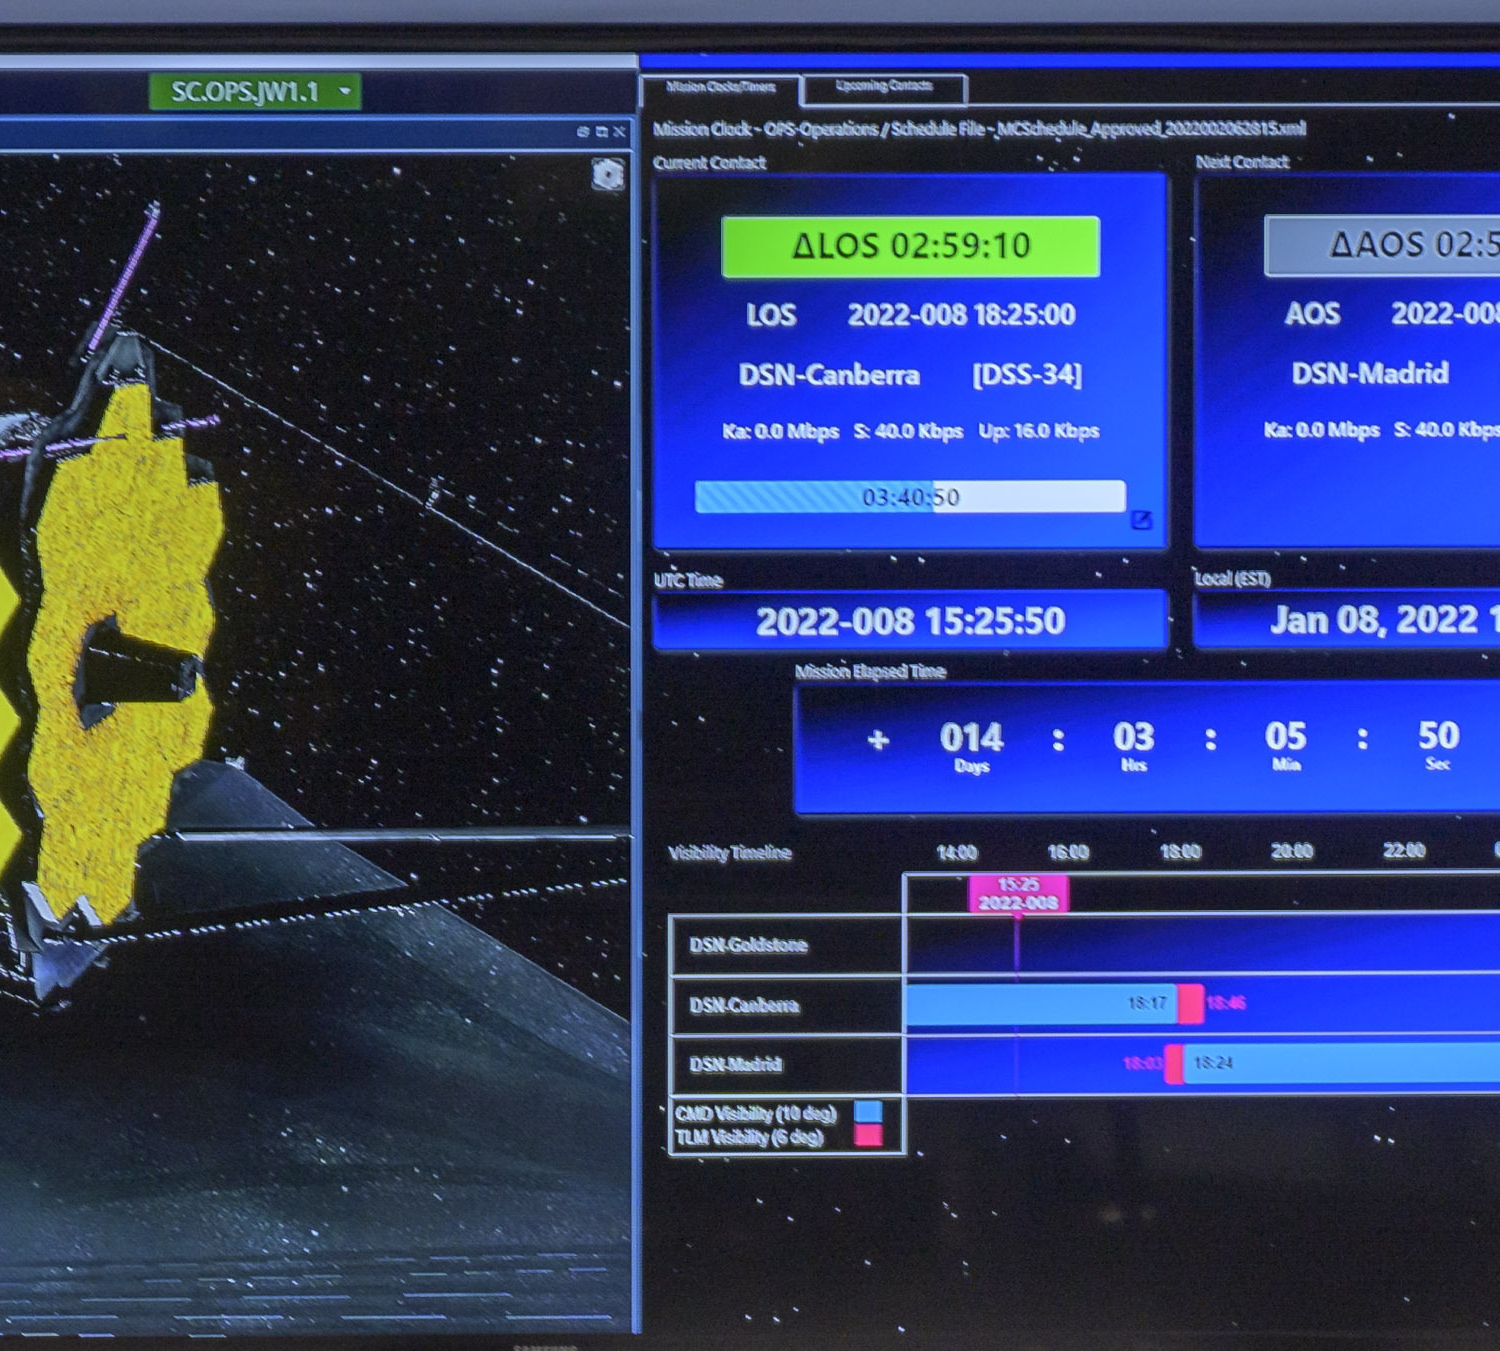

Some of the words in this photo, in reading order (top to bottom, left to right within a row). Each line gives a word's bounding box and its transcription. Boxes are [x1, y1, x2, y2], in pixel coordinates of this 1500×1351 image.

[171, 79, 320, 107] SC.OPS.JW1.1
[836, 79, 888, 94] Upcoming
[888, 79, 933, 93] Contacts
[652, 120, 709, 137] Mission
[710, 120, 753, 137] Clock
[890, 120, 958, 137] Schedule
[960, 119, 985, 137] File
[652, 155, 708, 171] Current
[709, 155, 768, 171] Contact
[1195, 154, 1232, 170] Next
[1232, 154, 1291, 170] Contact
[792, 231, 879, 259] ΔLOS
[891, 231, 1031, 259] 02:59:10
[1328, 230, 1424, 258] ΔAOS
[747, 303, 797, 328] LOS
[847, 303, 968, 328] 2022-008
[974, 303, 1076, 328] 18:25:00
[1285, 302, 1341, 327] AOS
[739, 362, 921, 387] DSN-Canberra
[973, 362, 1083, 390] [DSS-34]
[1292, 361, 1449, 386] DSN-Madrid
[754, 423, 784, 440] 0.0
[787, 422, 840, 444] Mbps
[874, 423, 915, 440] 40.0
[917, 422, 965, 444] Kbps
[1014, 423, 1051, 440] 16.0
[1053, 422, 1101, 444] Kbps
[1295, 421, 1325, 438] 0.0
[1327, 420, 1381, 442] Mbps
[1414, 421, 1455, 438] 40.0
[862, 487, 961, 508] 03:40:50
[654, 571, 684, 590] UTC
[686, 571, 724, 590] Time
[1194, 569, 1233, 588] Local
[1235, 569, 1272, 590] (EST)
[756, 606, 916, 637] 2022-008
[925, 606, 1067, 637] 15:25:50
[1270, 604, 1329, 635] Jan
[1336, 604, 1388, 639] 08,
[1396, 604, 1479, 635] 2022
[795, 662, 851, 681] Mission
[852, 662, 908, 684] Elapsed
[910, 662, 948, 681] Time
[940, 721, 1005, 753] 014
[1113, 721, 1156, 753] 03
[1264, 720, 1308, 752] 05
[1417, 720, 1462, 751] 50
[954, 757, 991, 776] Days
[1120, 757, 1149, 773] Hrs
[1271, 757, 1302, 773] Min
[1424, 757, 1452, 773] Sec
[668, 843, 730, 864] Visibility
[730, 843, 793, 861] Timeline
[936, 844, 979, 861] 14:00
[1047, 844, 1091, 860] 16:00
[1160, 843, 1203, 860] 18:00
[1270, 841, 1315, 860] 20:00
[1382, 841, 1427, 859] 22:00
[714, 1104, 773, 1125] Visibility
[802, 1104, 838, 1125] deg)
[710, 1128, 770, 1148] Visibility
[790, 1128, 825, 1148] deg)
